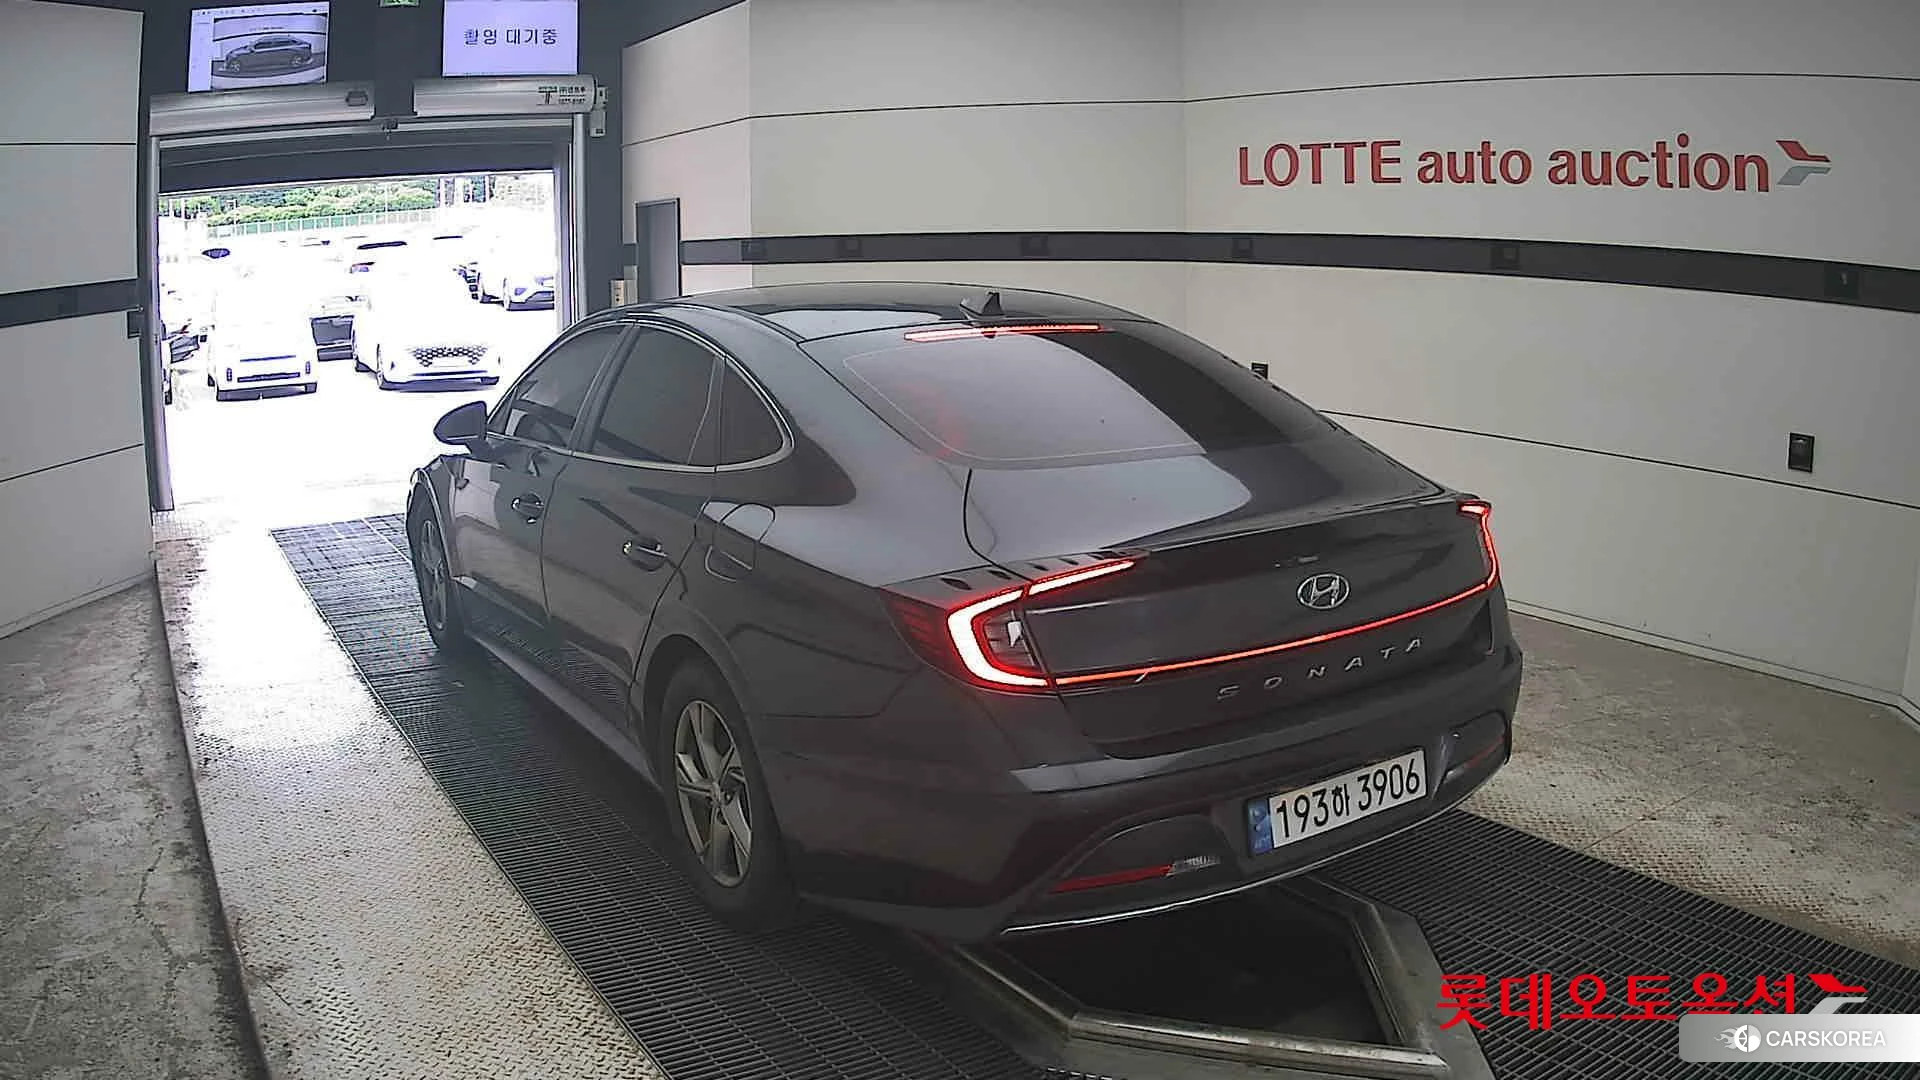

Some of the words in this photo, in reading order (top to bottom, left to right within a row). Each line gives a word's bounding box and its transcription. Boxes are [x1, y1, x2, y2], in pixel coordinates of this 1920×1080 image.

[506, 28, 558, 45] 대기중
[1238, 140, 1401, 187] LOTTE
[1417, 141, 1533, 185] auto
[1547, 133, 1769, 193] auction
[1217, 638, 1422, 701] SONATA
[1276, 783, 1350, 839] 193하
[1357, 758, 1421, 812] 3906
